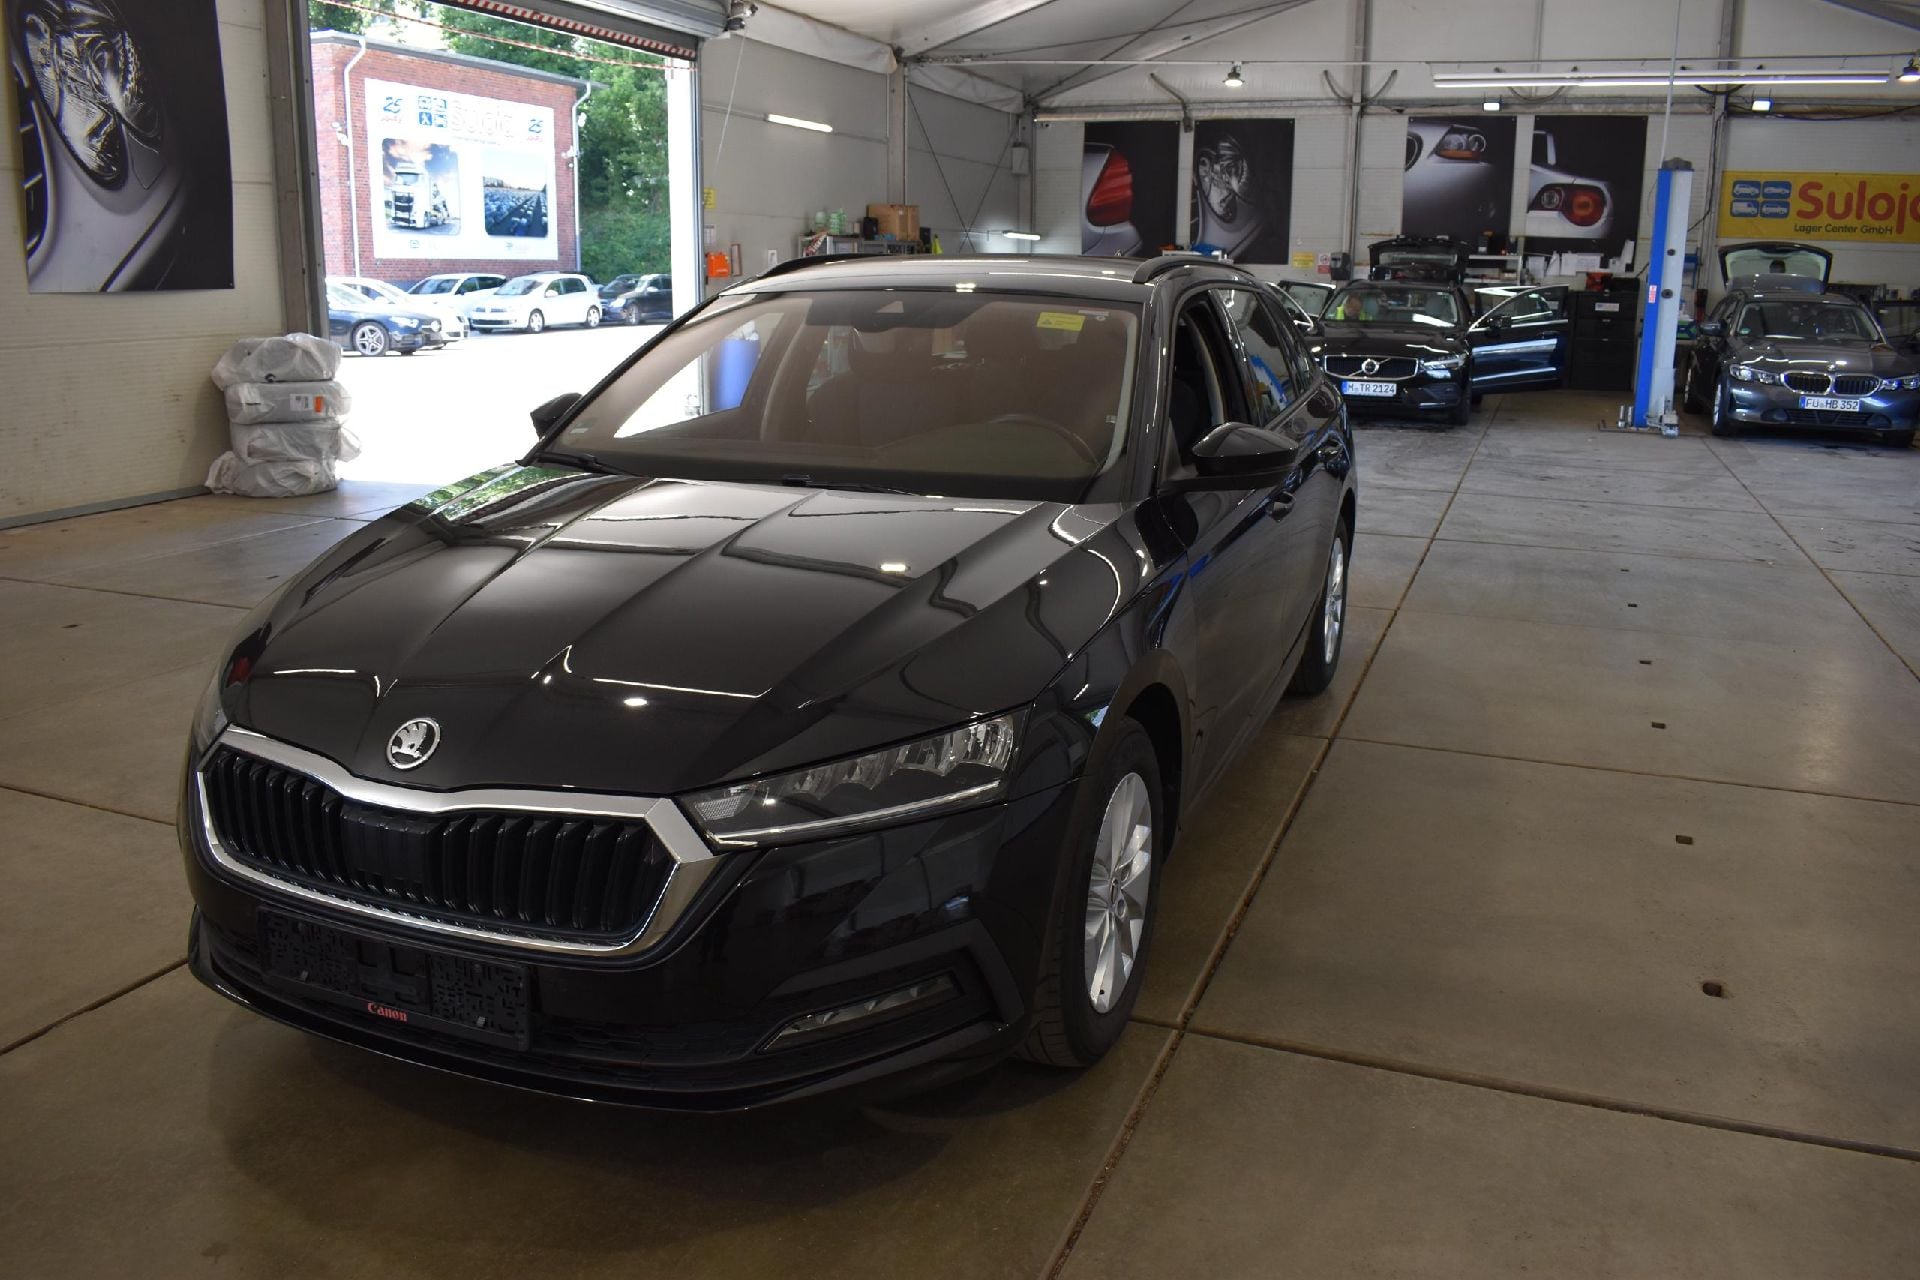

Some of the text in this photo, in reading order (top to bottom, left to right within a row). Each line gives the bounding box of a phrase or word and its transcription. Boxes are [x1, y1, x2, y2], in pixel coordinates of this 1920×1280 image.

[1794, 223, 1893, 235] Lager Center GmbH
[1360, 383, 1371, 393] TR
[1372, 384, 1395, 393] 2124
[1825, 399, 1839, 409] HB
[1840, 400, 1859, 410] 352
[367, 1002, 408, 1022] Canon
